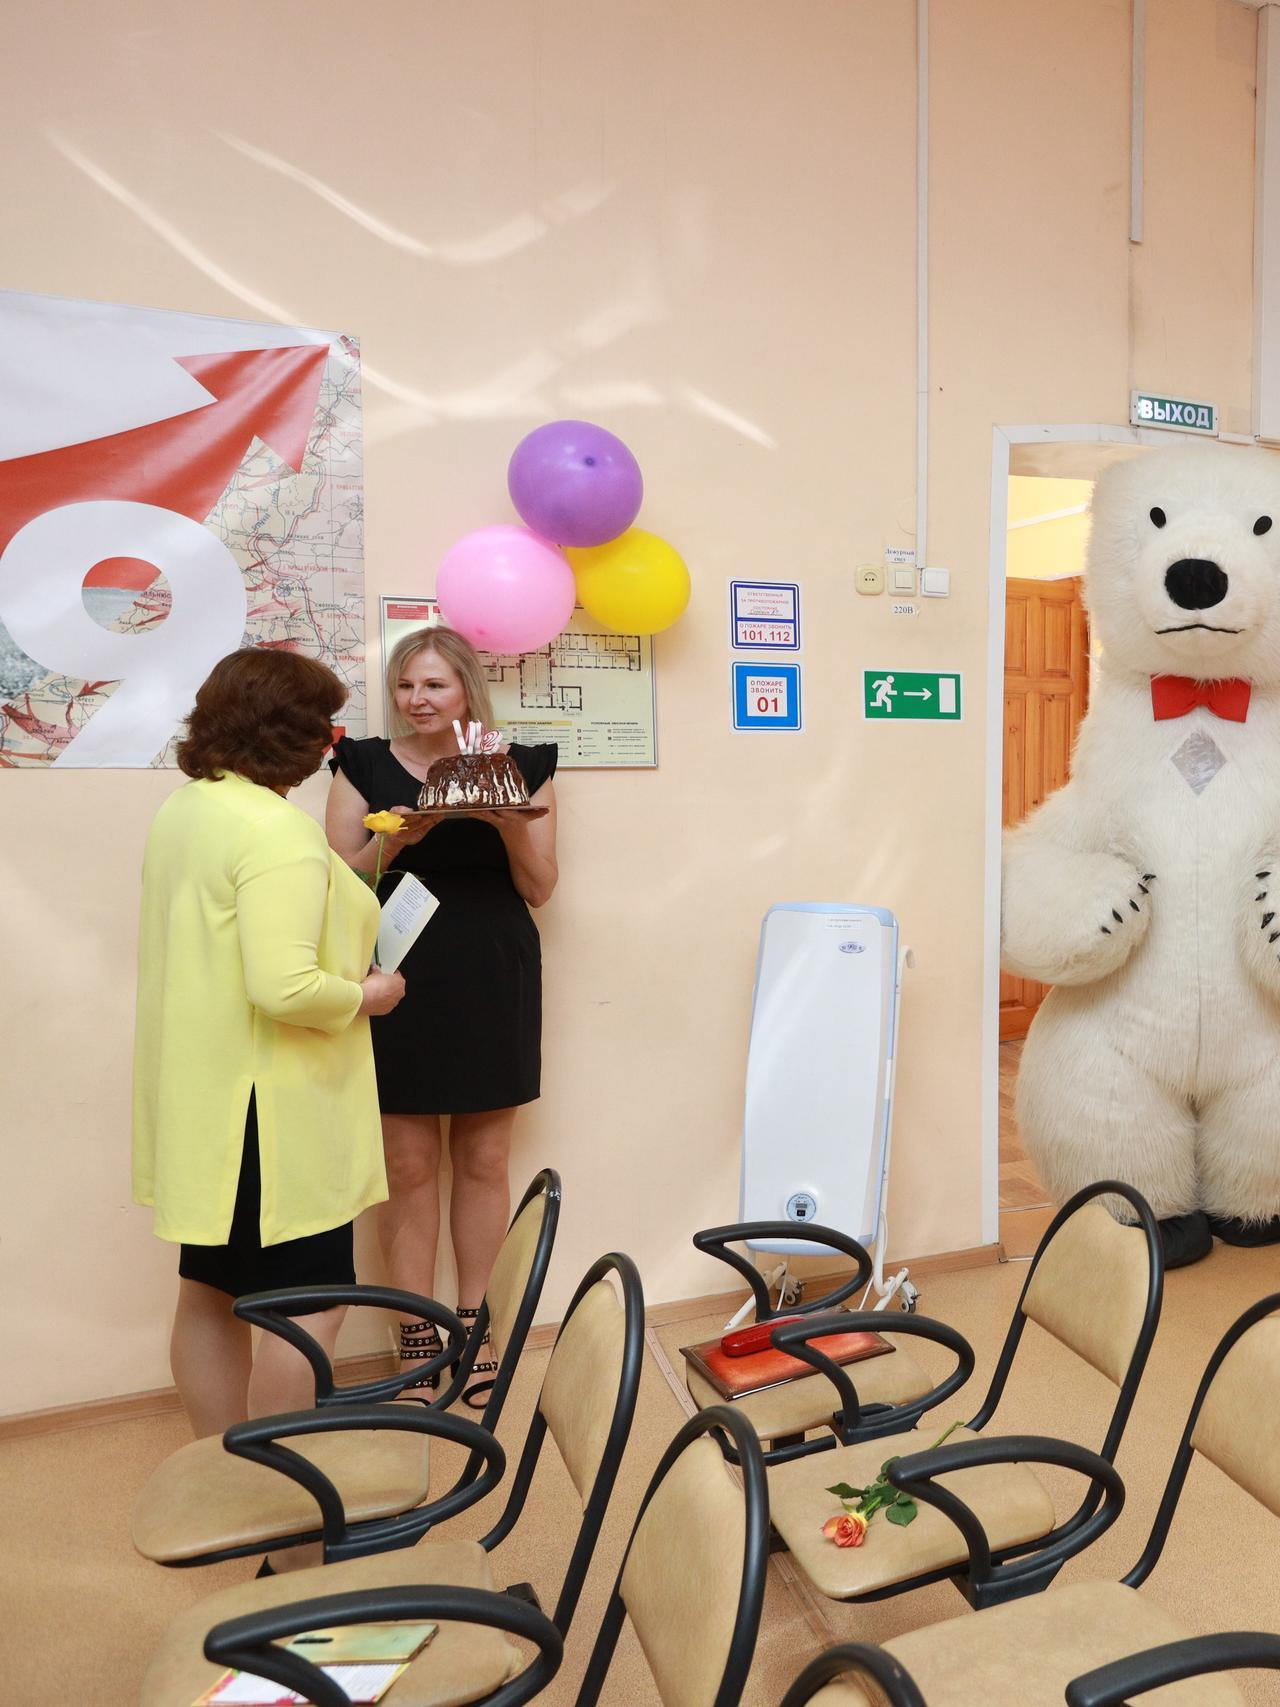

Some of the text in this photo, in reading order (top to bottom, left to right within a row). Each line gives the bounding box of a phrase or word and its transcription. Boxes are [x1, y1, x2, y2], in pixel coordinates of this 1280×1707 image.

[1140, 399, 1210, 428] ВЫХОД
[894, 606, 914, 614] 220В
[757, 696, 778, 713] 01
